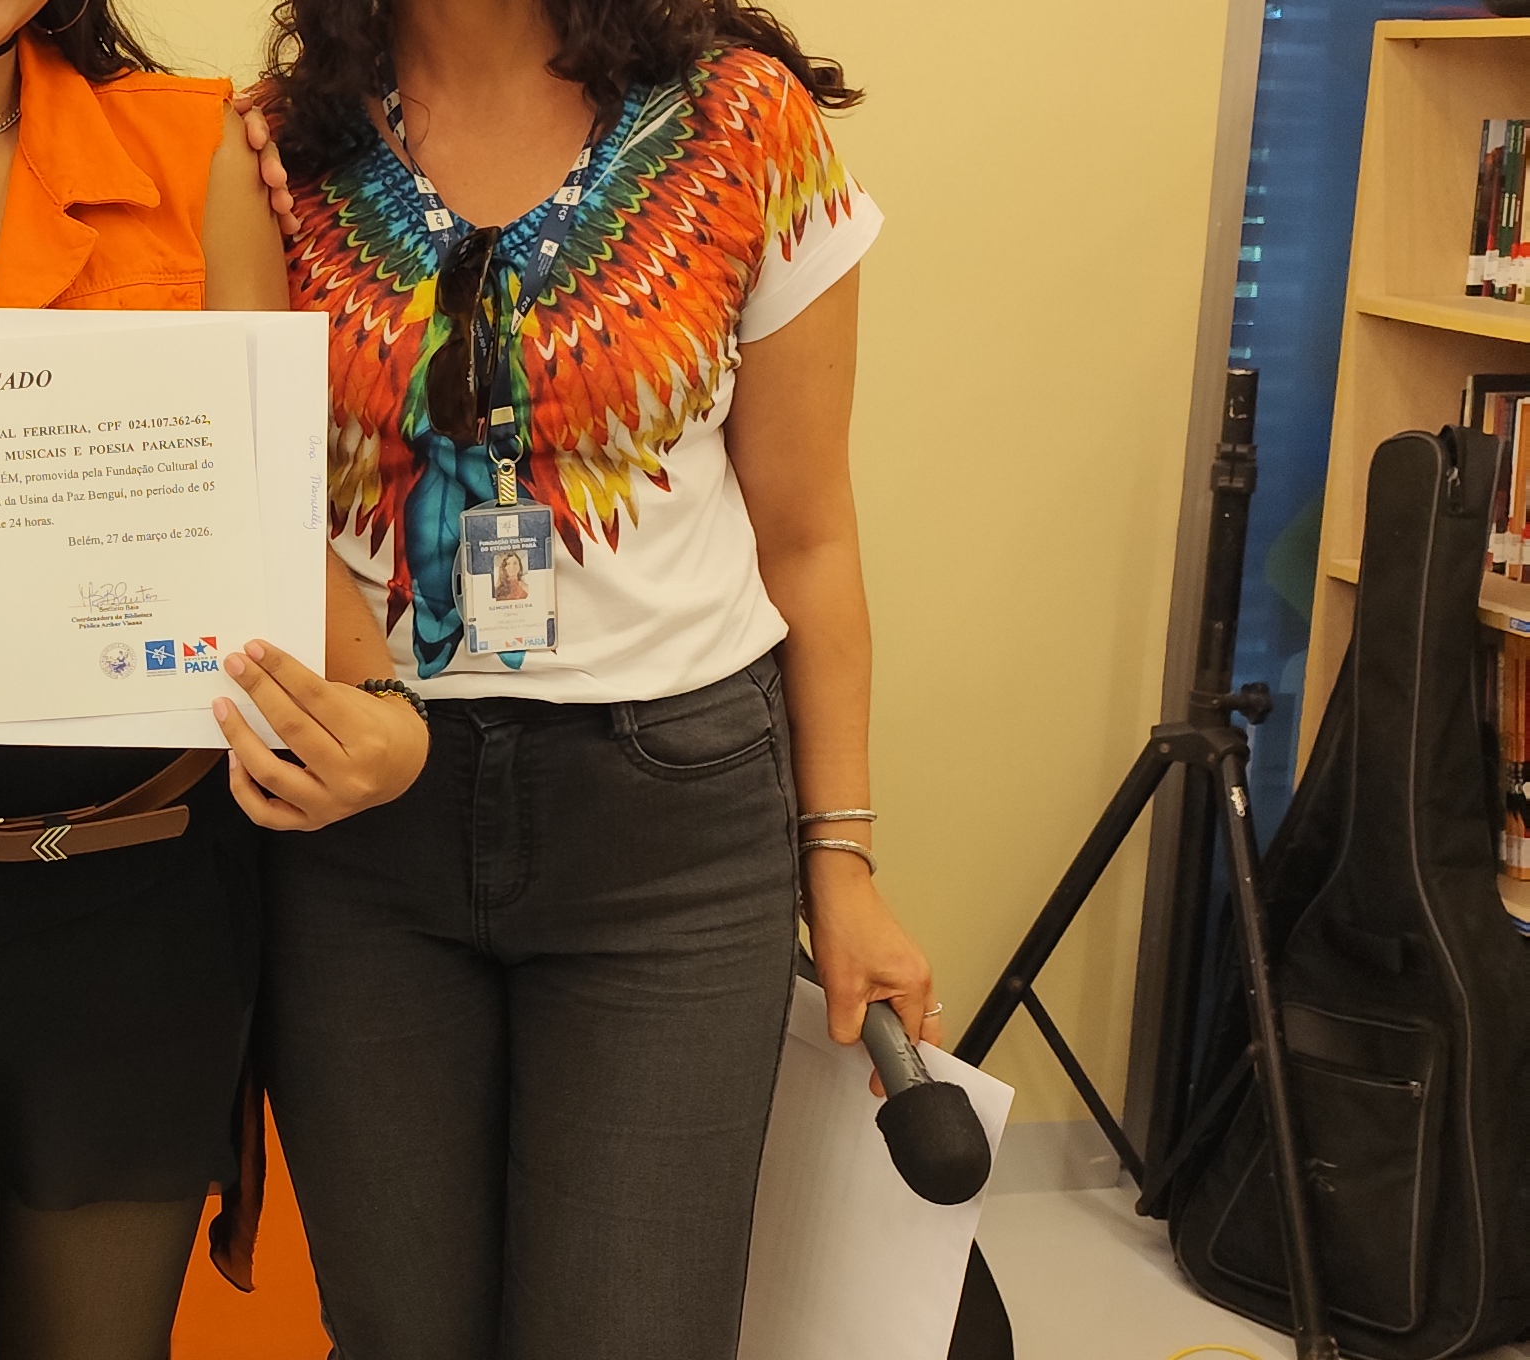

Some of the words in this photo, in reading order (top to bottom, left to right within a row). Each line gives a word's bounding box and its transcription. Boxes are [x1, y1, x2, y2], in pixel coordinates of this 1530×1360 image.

[97, 420, 122, 432] CPF
[4, 447, 67, 462] MUSICAIS
[73, 446, 83, 457] E
[88, 442, 135, 455] POESIA
[142, 436, 213, 452] PARAENSE,
[24, 469, 80, 485] promovida
[82, 467, 103, 481] pela
[105, 464, 155, 477] Fundação
[157, 459, 199, 473] Cultural
[201, 458, 214, 470] do
[4, 496, 17, 506] da
[19, 494, 49, 505] Usina
[51, 492, 64, 503] da
[66, 491, 86, 502] Paz
[130, 489, 143, 497] no
[146, 483, 185, 499] período
[187, 482, 200, 493] de
[202, 481, 215, 492] 05
[8, 517, 22, 528] 24
[24, 517, 55, 527] horas.
[68, 535, 104, 547] Belém,
[106, 533, 119, 544] 27
[121, 532, 134, 543] de
[136, 532, 168, 542] março
[169, 528, 182, 539] de
[184, 526, 213, 538] 2026.
